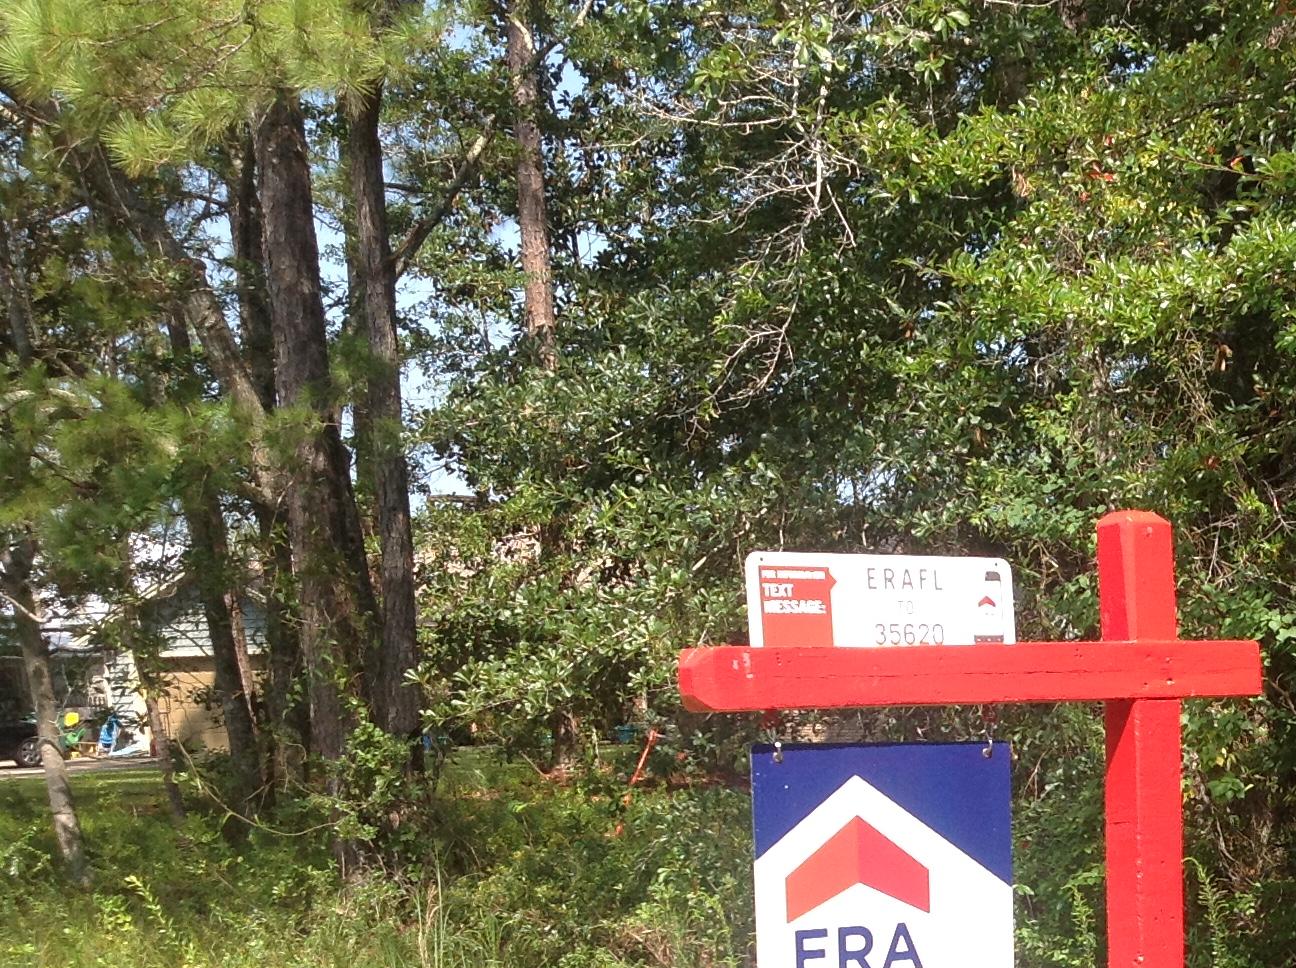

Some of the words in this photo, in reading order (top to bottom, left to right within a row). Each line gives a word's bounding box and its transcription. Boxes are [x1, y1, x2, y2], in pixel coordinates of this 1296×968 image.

[867, 568, 943, 590] ERAFL
[762, 583, 794, 598] TEXT
[898, 600, 914, 614] TO
[875, 624, 944, 645] 35620
